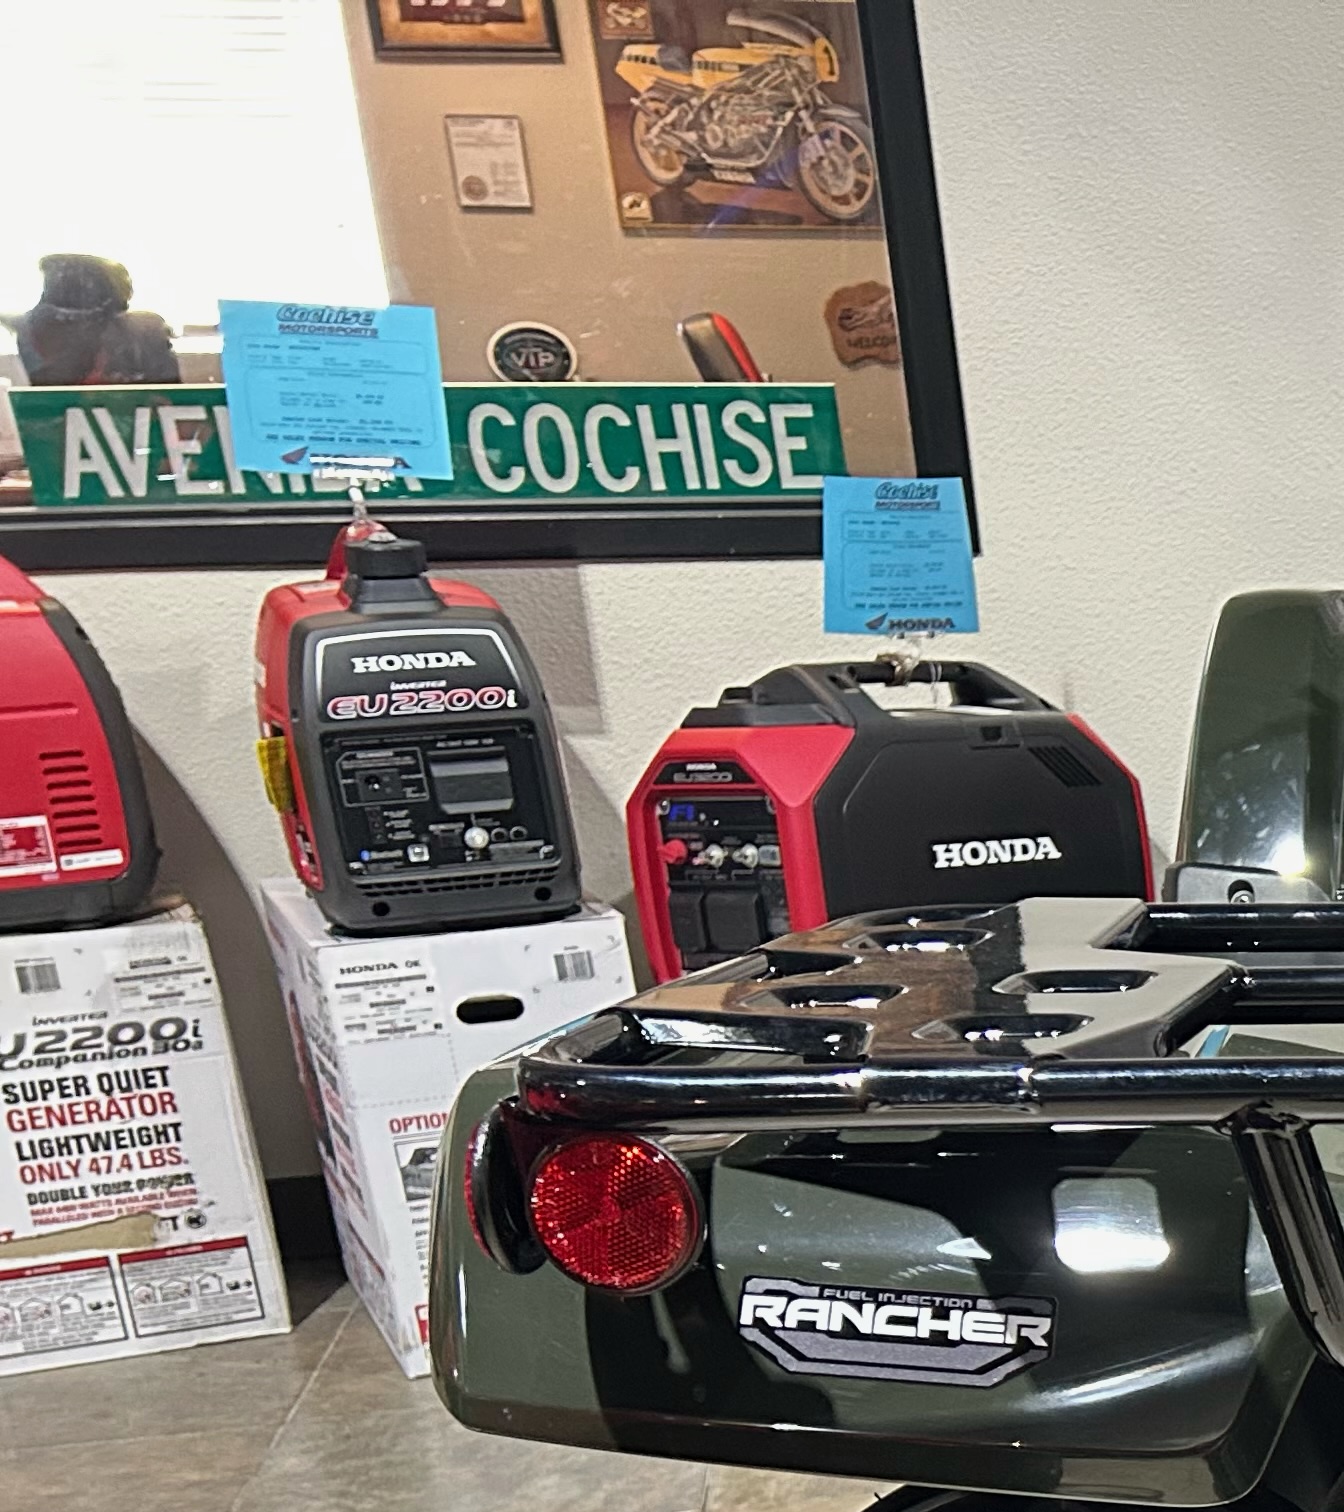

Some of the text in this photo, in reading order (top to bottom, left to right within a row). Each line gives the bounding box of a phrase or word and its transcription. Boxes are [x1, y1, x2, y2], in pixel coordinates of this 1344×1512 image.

[276, 304, 376, 326] Cochise
[278, 325, 379, 339] MOTORSPORTS
[510, 348, 555, 368] VIP
[468, 401, 822, 494] COCHISE
[875, 481, 939, 500] Cochise
[888, 617, 956, 630] HONDA
[351, 651, 477, 674] HONDA
[326, 686, 518, 720] EU2200i
[932, 836, 1062, 869] HONDA
[339, 962, 398, 975] HONDA
[1, 1065, 170, 1105] SUPER QUIET
[6, 1091, 179, 1133] GENERATOR
[14, 1121, 183, 1162] LIGHTWEIGHT
[19, 1146, 190, 1185] ONLY 47.4 LBS.
[26, 1185, 89, 1206] DOUBLE
[91, 1180, 134, 1197] YOUR
[823, 1288, 875, 1301] FUEL
[739, 1294, 1051, 1347] RANCHER
